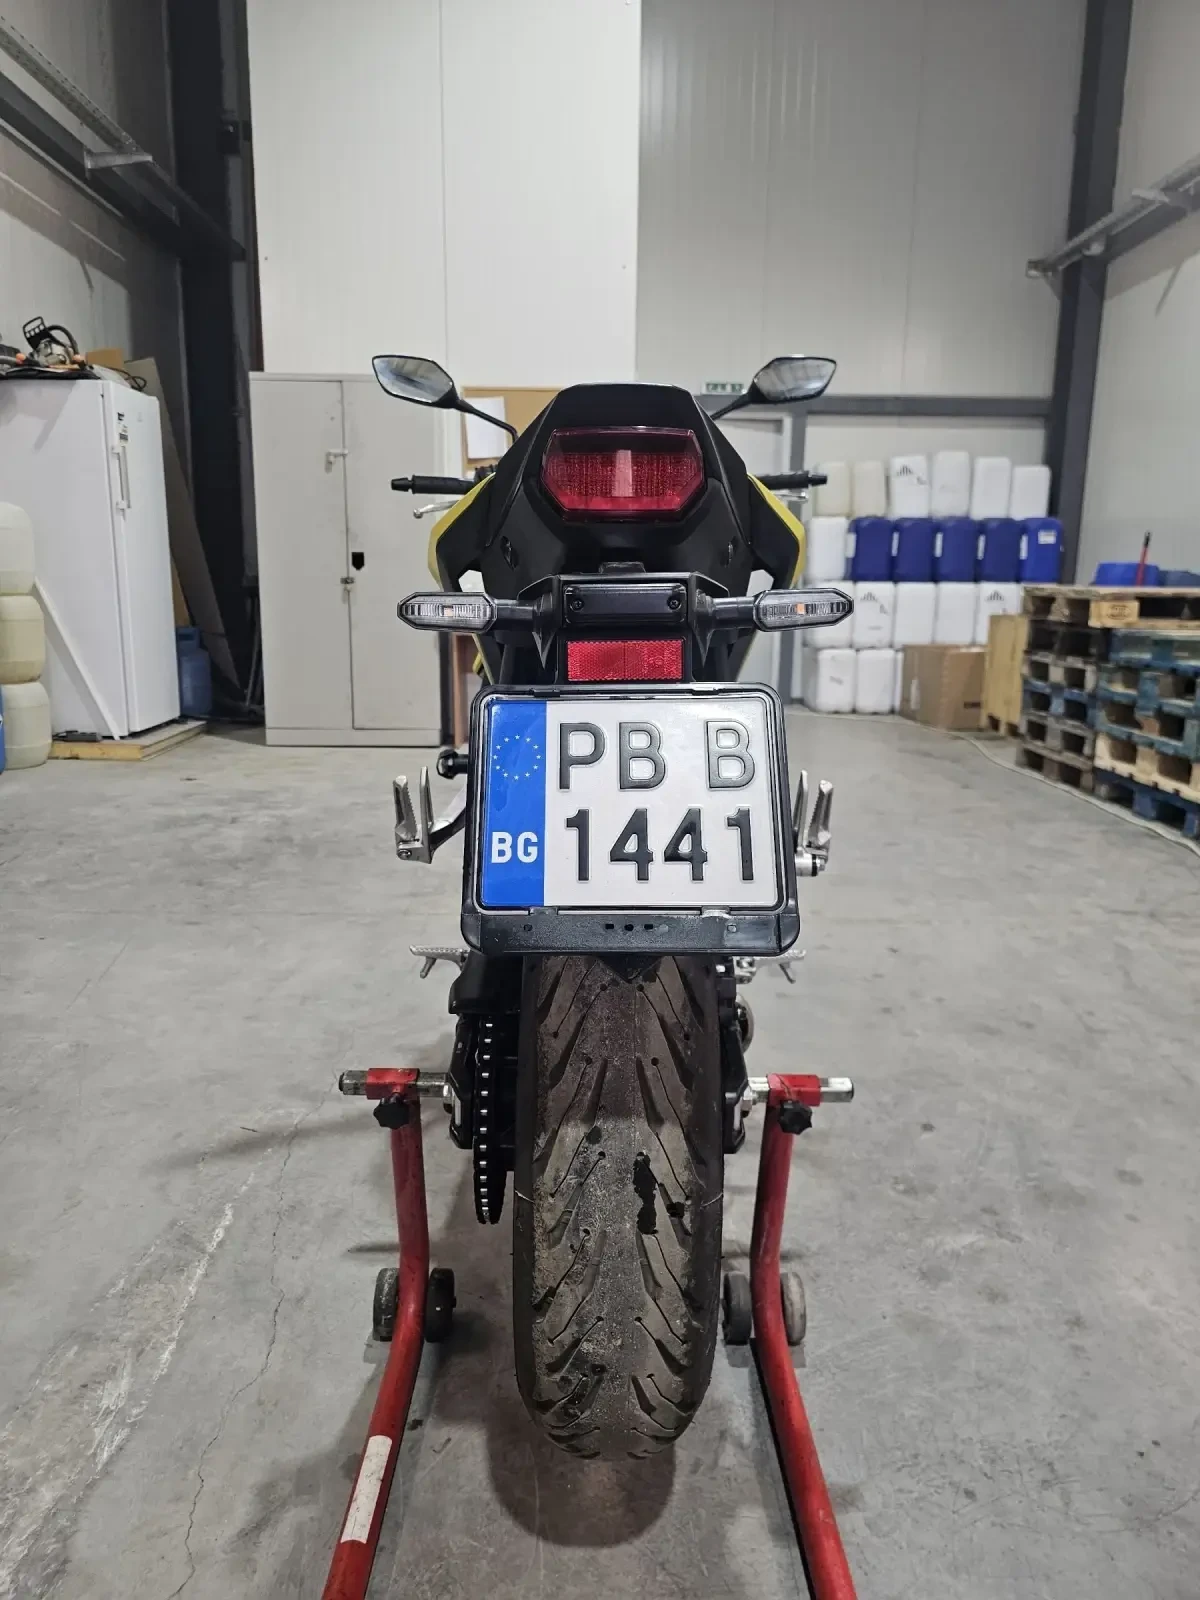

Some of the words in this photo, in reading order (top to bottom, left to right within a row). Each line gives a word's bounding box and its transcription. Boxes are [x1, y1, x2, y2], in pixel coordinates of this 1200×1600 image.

[559, 721, 666, 790] PB
[706, 720, 755, 789] B
[491, 831, 538, 863] BG
[566, 807, 755, 881] 1441
